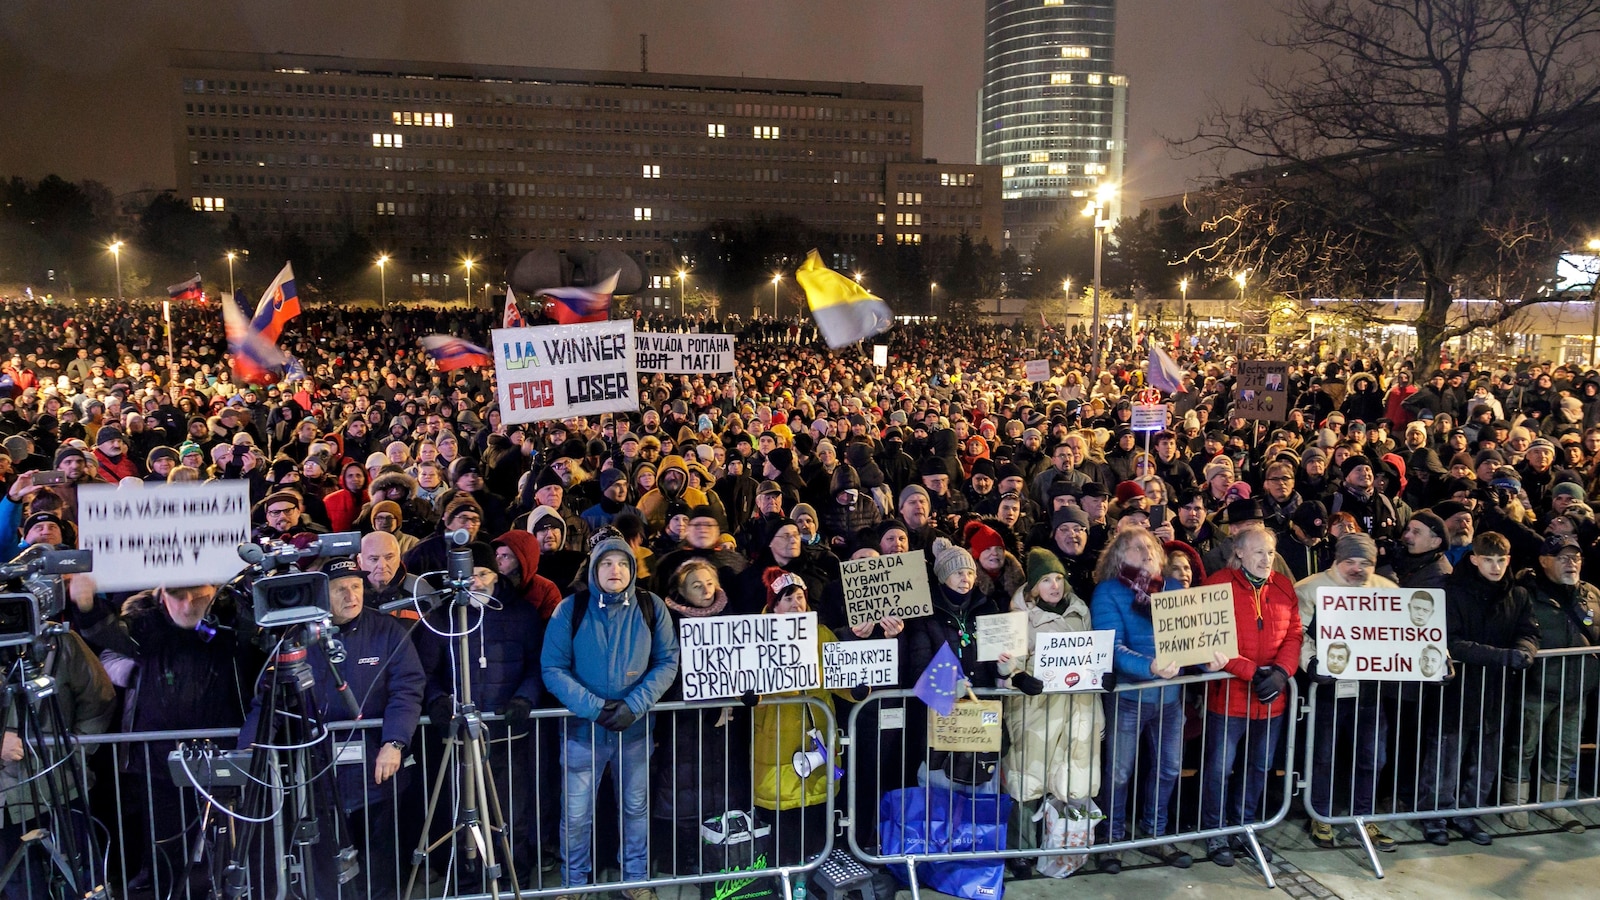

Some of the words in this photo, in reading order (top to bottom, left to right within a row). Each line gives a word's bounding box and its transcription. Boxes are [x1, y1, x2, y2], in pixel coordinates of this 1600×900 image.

[504, 341, 540, 370] UA
[543, 333, 626, 366] WINNER
[652, 335, 683, 352] VLÁDA
[688, 335, 730, 353] POMÁHA
[681, 353, 720, 370] MAFII
[509, 379, 555, 411] FICO
[565, 371, 629, 405] LOSER
[842, 561, 866, 574] KDE
[868, 559, 885, 570] SA
[1154, 594, 1197, 610] PODLIAK
[1201, 590, 1229, 604] FICO
[1322, 592, 1402, 611] PATRÍTE
[889, 605, 920, 617] 4000
[922, 603, 930, 613] €
[1158, 610, 1229, 633] DEMONTUJE
[682, 619, 751, 647] POLITIKA
[755, 618, 779, 643] NIE
[786, 616, 807, 641] JE
[1320, 625, 1346, 640] NA
[1350, 626, 1443, 642] SMETISKO
[824, 642, 841, 653] KDE
[1159, 635, 1195, 654] PRÁVNY
[1197, 629, 1230, 648] ŠTÁT
[756, 643, 801, 669] PRED
[824, 649, 858, 666] VLÁDA
[860, 649, 892, 664] KRYJE
[1040, 651, 1092, 668] ŠPINAVÁ
[1356, 653, 1412, 672] DEJÍN
[824, 666, 841, 674] TAM
[825, 672, 857, 688] MAFIA
[860, 667, 892, 685] ŽIJE
[936, 717, 957, 725] FICO
